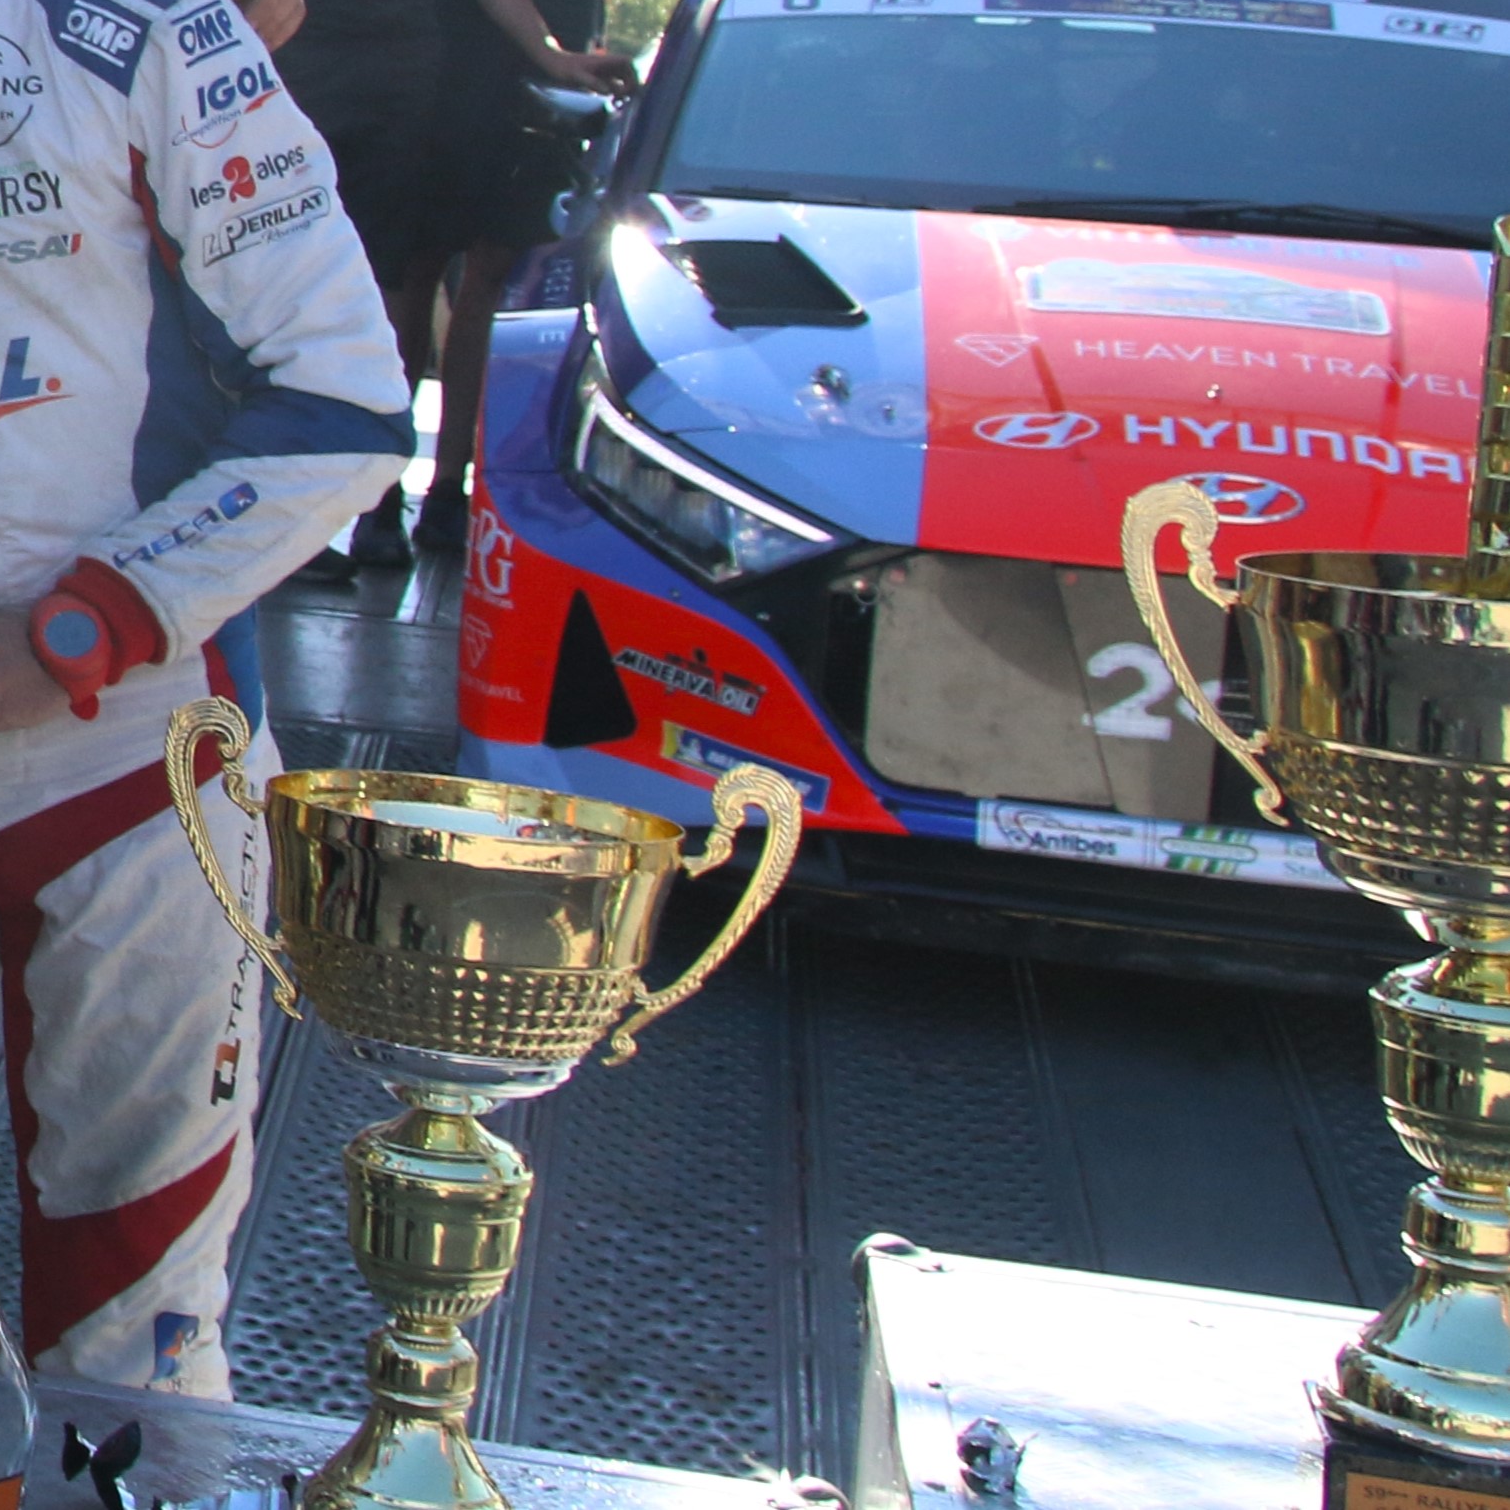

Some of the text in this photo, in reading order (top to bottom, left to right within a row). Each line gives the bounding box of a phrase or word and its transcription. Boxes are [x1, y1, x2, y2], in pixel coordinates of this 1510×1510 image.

[64, 8, 138, 56] OMP
[178, 7, 233, 57] OMP
[190, 180, 226, 209] les
[256, 145, 306, 180] alpes
[1075, 338, 1480, 400] HEAVEN TRAVEL
[612, 647, 759, 715] MINERVA OIL
[1030, 831, 1117, 858] Antibes
